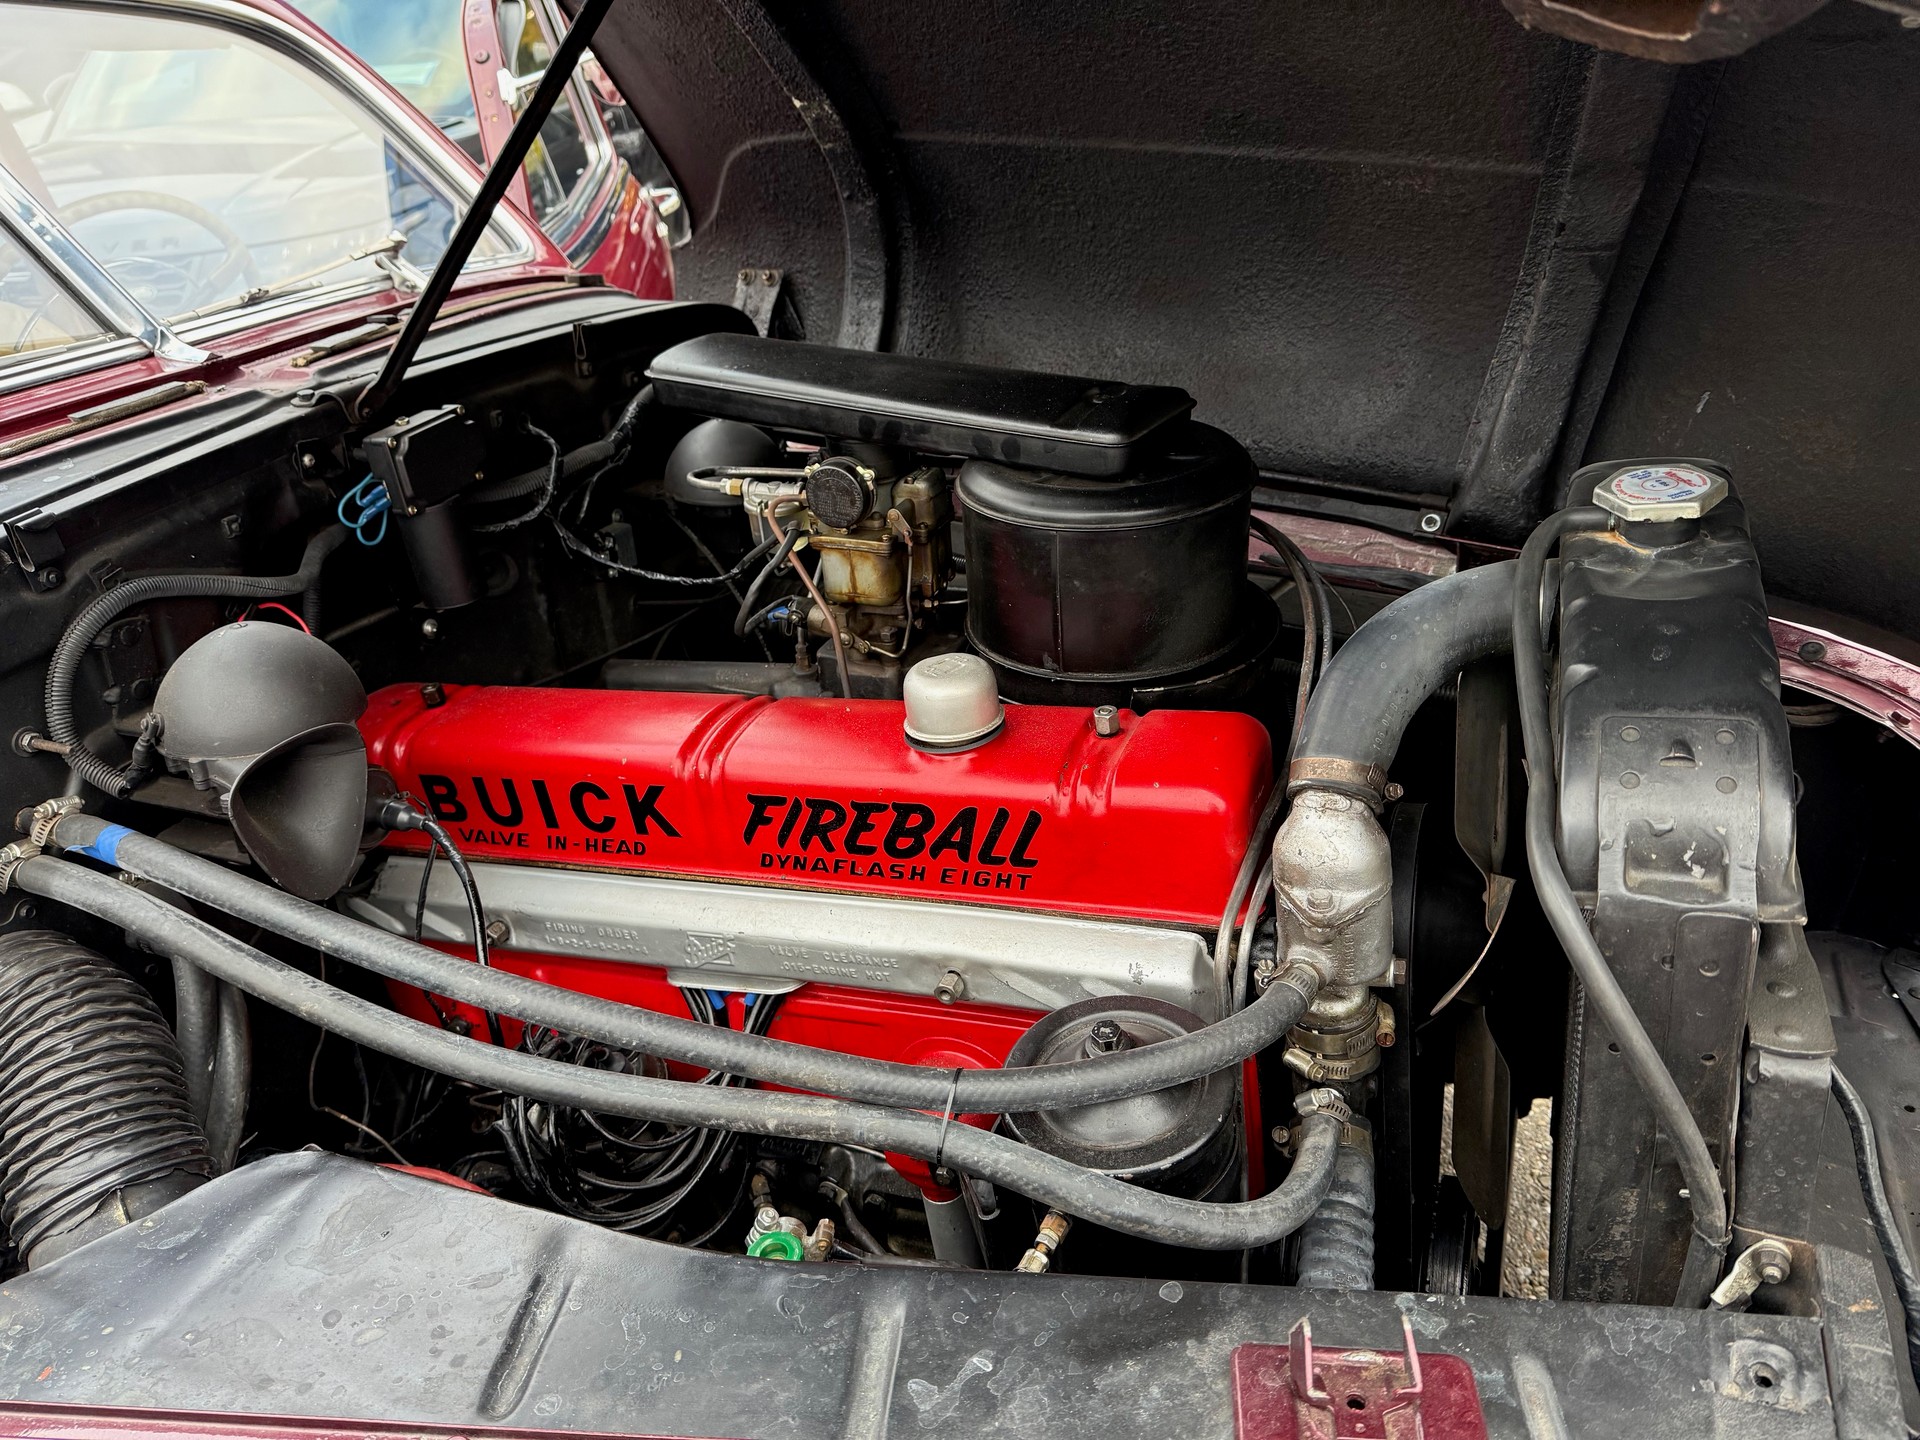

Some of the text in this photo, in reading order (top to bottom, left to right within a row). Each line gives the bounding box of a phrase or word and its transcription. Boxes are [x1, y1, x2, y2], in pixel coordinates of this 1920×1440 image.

[419, 774, 682, 838] BUICK
[458, 827, 646, 856] VALVE IN-HEAD
[743, 793, 1043, 869] FIREBALL
[760, 853, 1032, 890] DYNAFLASH EIGHT
[545, 921, 639, 940] FIRING ORDER
[768, 944, 899, 969] VALVE CLEARANCE
[865, 969, 891, 982] HOT
